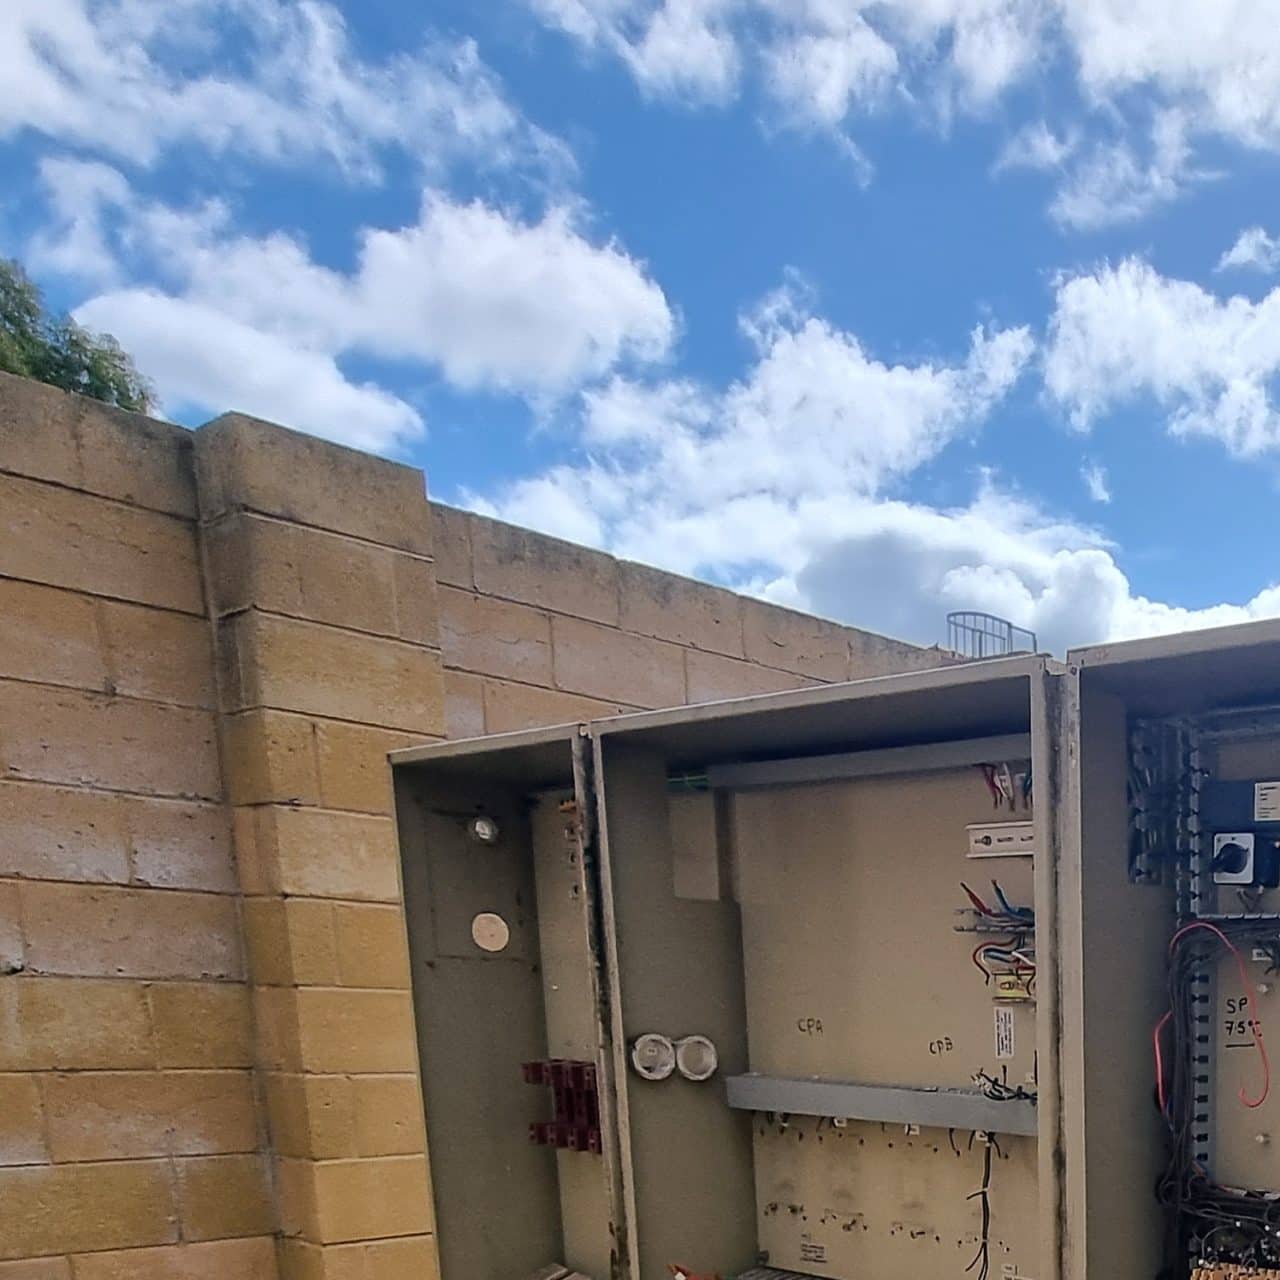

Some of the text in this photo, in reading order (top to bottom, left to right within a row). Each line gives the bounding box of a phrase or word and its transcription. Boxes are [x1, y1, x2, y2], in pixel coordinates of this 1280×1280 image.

[1226, 996, 1248, 1014] SP
[797, 1018, 824, 1036] CPA
[928, 1036, 954, 1056] CPB
